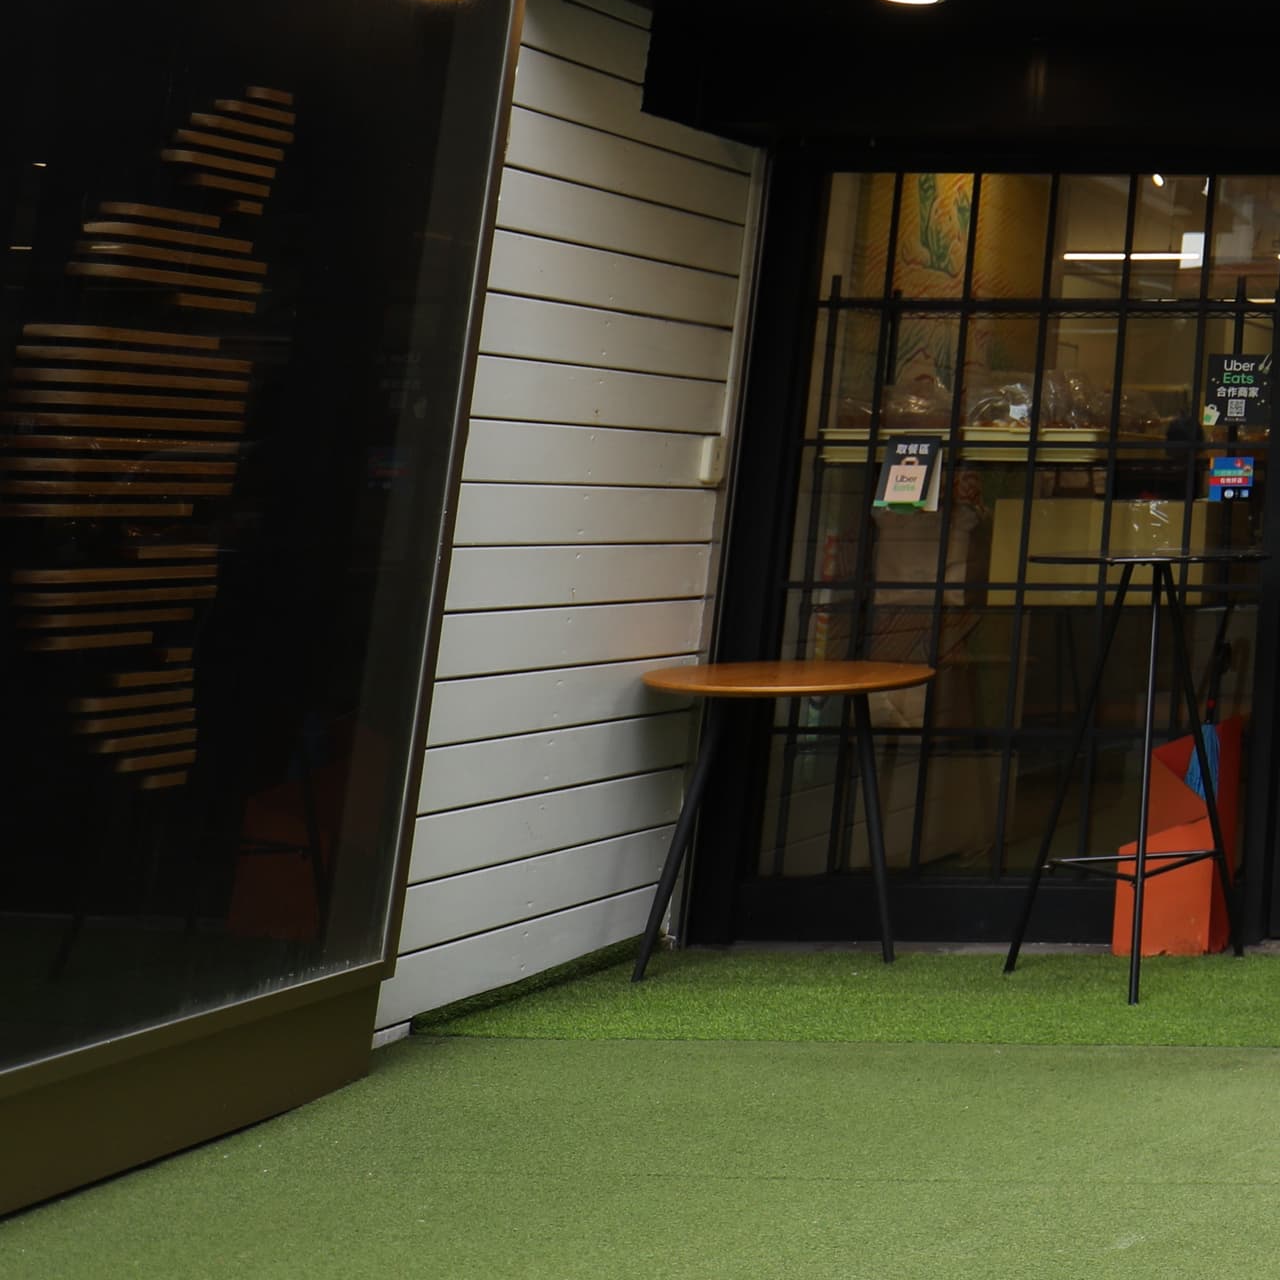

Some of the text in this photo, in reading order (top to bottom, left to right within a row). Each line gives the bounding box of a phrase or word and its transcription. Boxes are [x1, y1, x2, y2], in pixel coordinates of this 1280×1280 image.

[1223, 359, 1255, 372] Uber
[1223, 372, 1254, 384] Eats
[1216, 386, 1259, 398] 合作商家
[895, 443, 931, 455] 取餐區
[895, 474, 918, 483] Uber
